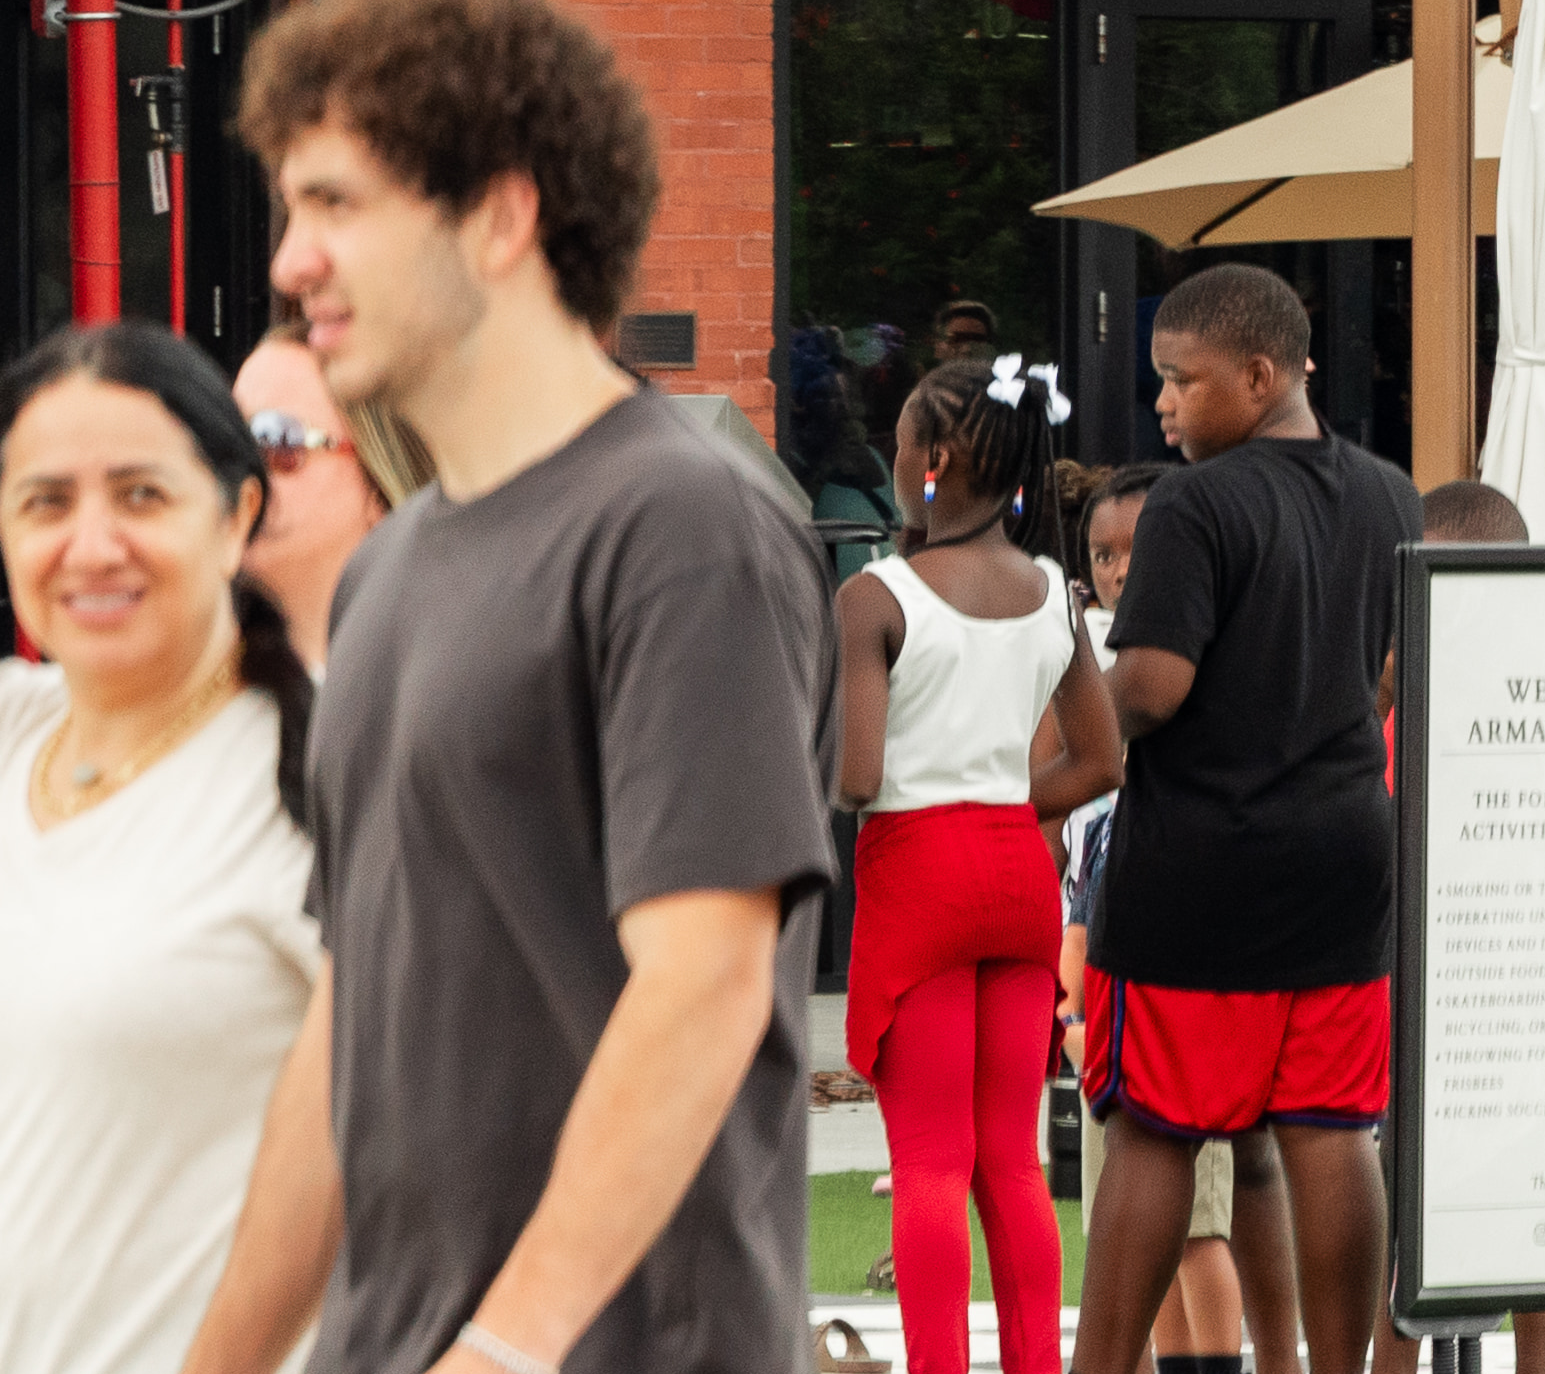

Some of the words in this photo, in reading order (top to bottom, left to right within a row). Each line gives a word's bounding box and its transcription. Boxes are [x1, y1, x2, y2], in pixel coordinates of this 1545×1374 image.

[1473, 791, 1510, 809] THE
[1445, 882, 1509, 898] SMOKING
[1514, 882, 1532, 896] OR
[1444, 1077, 1503, 1091] FRISBEES
[1443, 1105, 1502, 1120] KICKING
